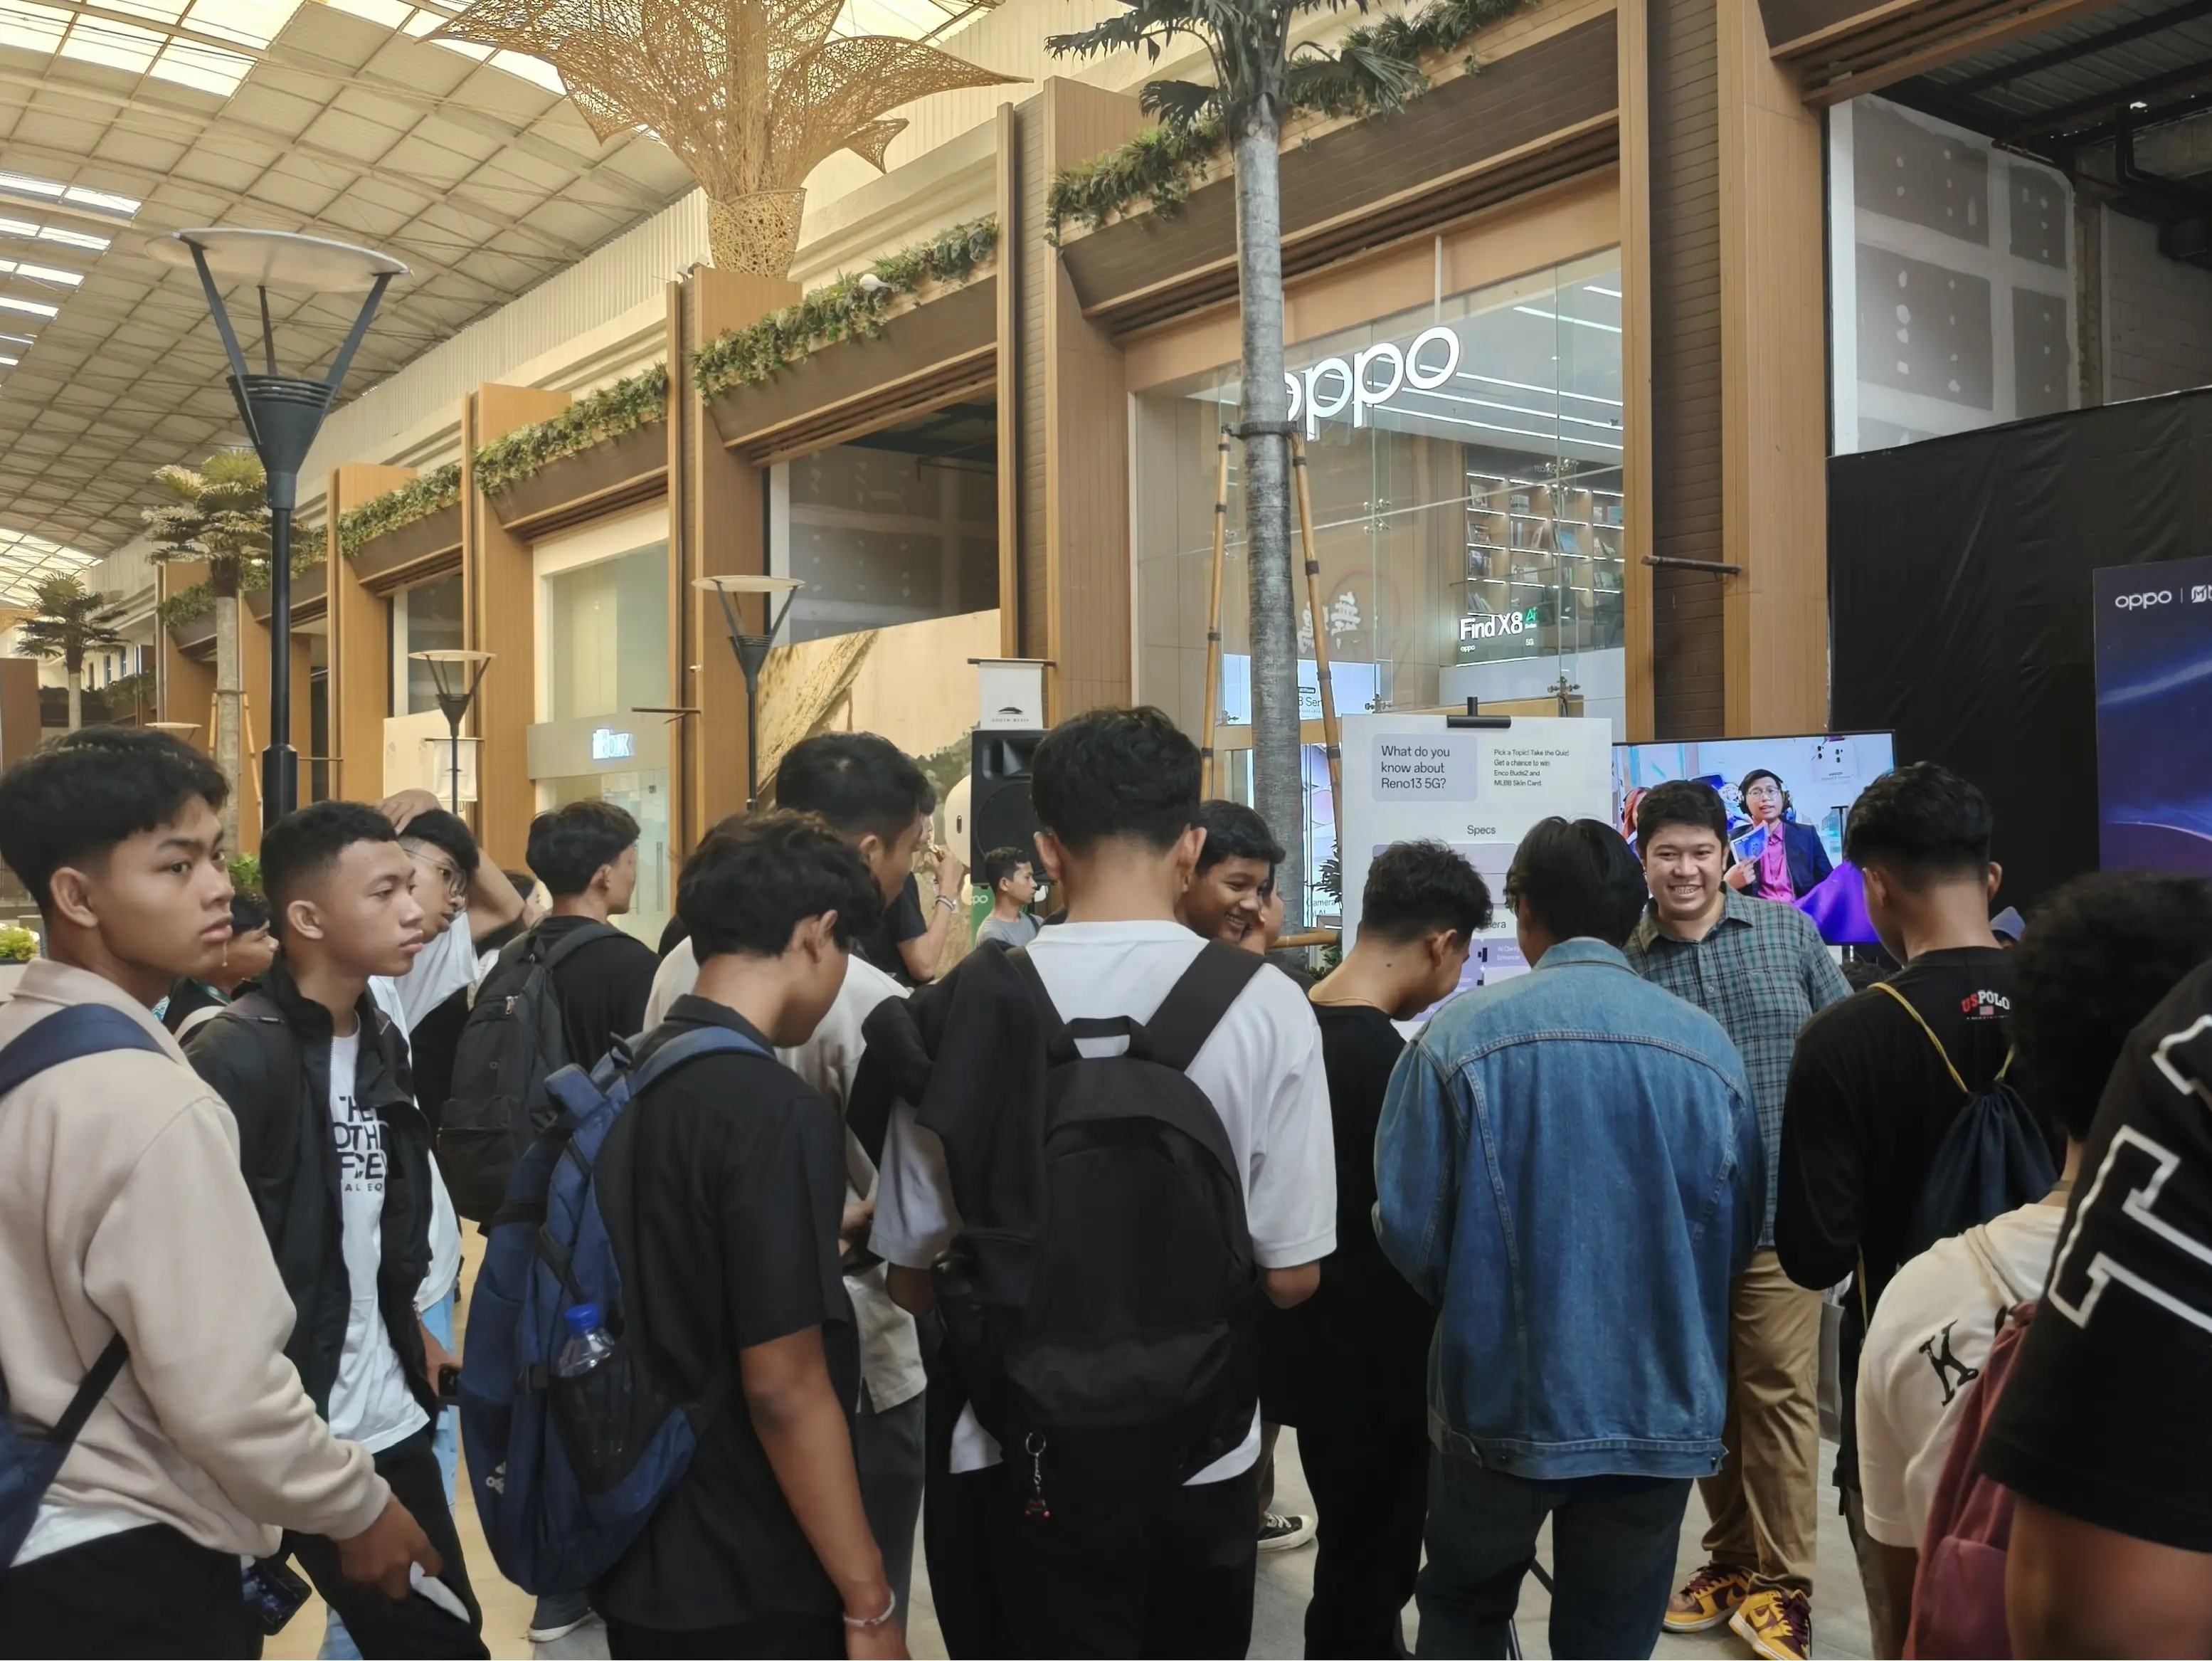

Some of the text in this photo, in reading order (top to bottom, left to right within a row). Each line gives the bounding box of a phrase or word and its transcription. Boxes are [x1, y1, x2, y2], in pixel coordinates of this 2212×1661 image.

[2115, 591, 2172, 611] oppo
[1460, 611, 1523, 640] Find X8
[1460, 644, 1476, 653] oppo
[1381, 745, 1450, 759] What do you
[1381, 761, 1445, 774] know about
[1382, 777, 1446, 789] Reno13 5G?
[1467, 824, 1496, 836] Specs
[1977, 990, 2010, 1010] POLO
